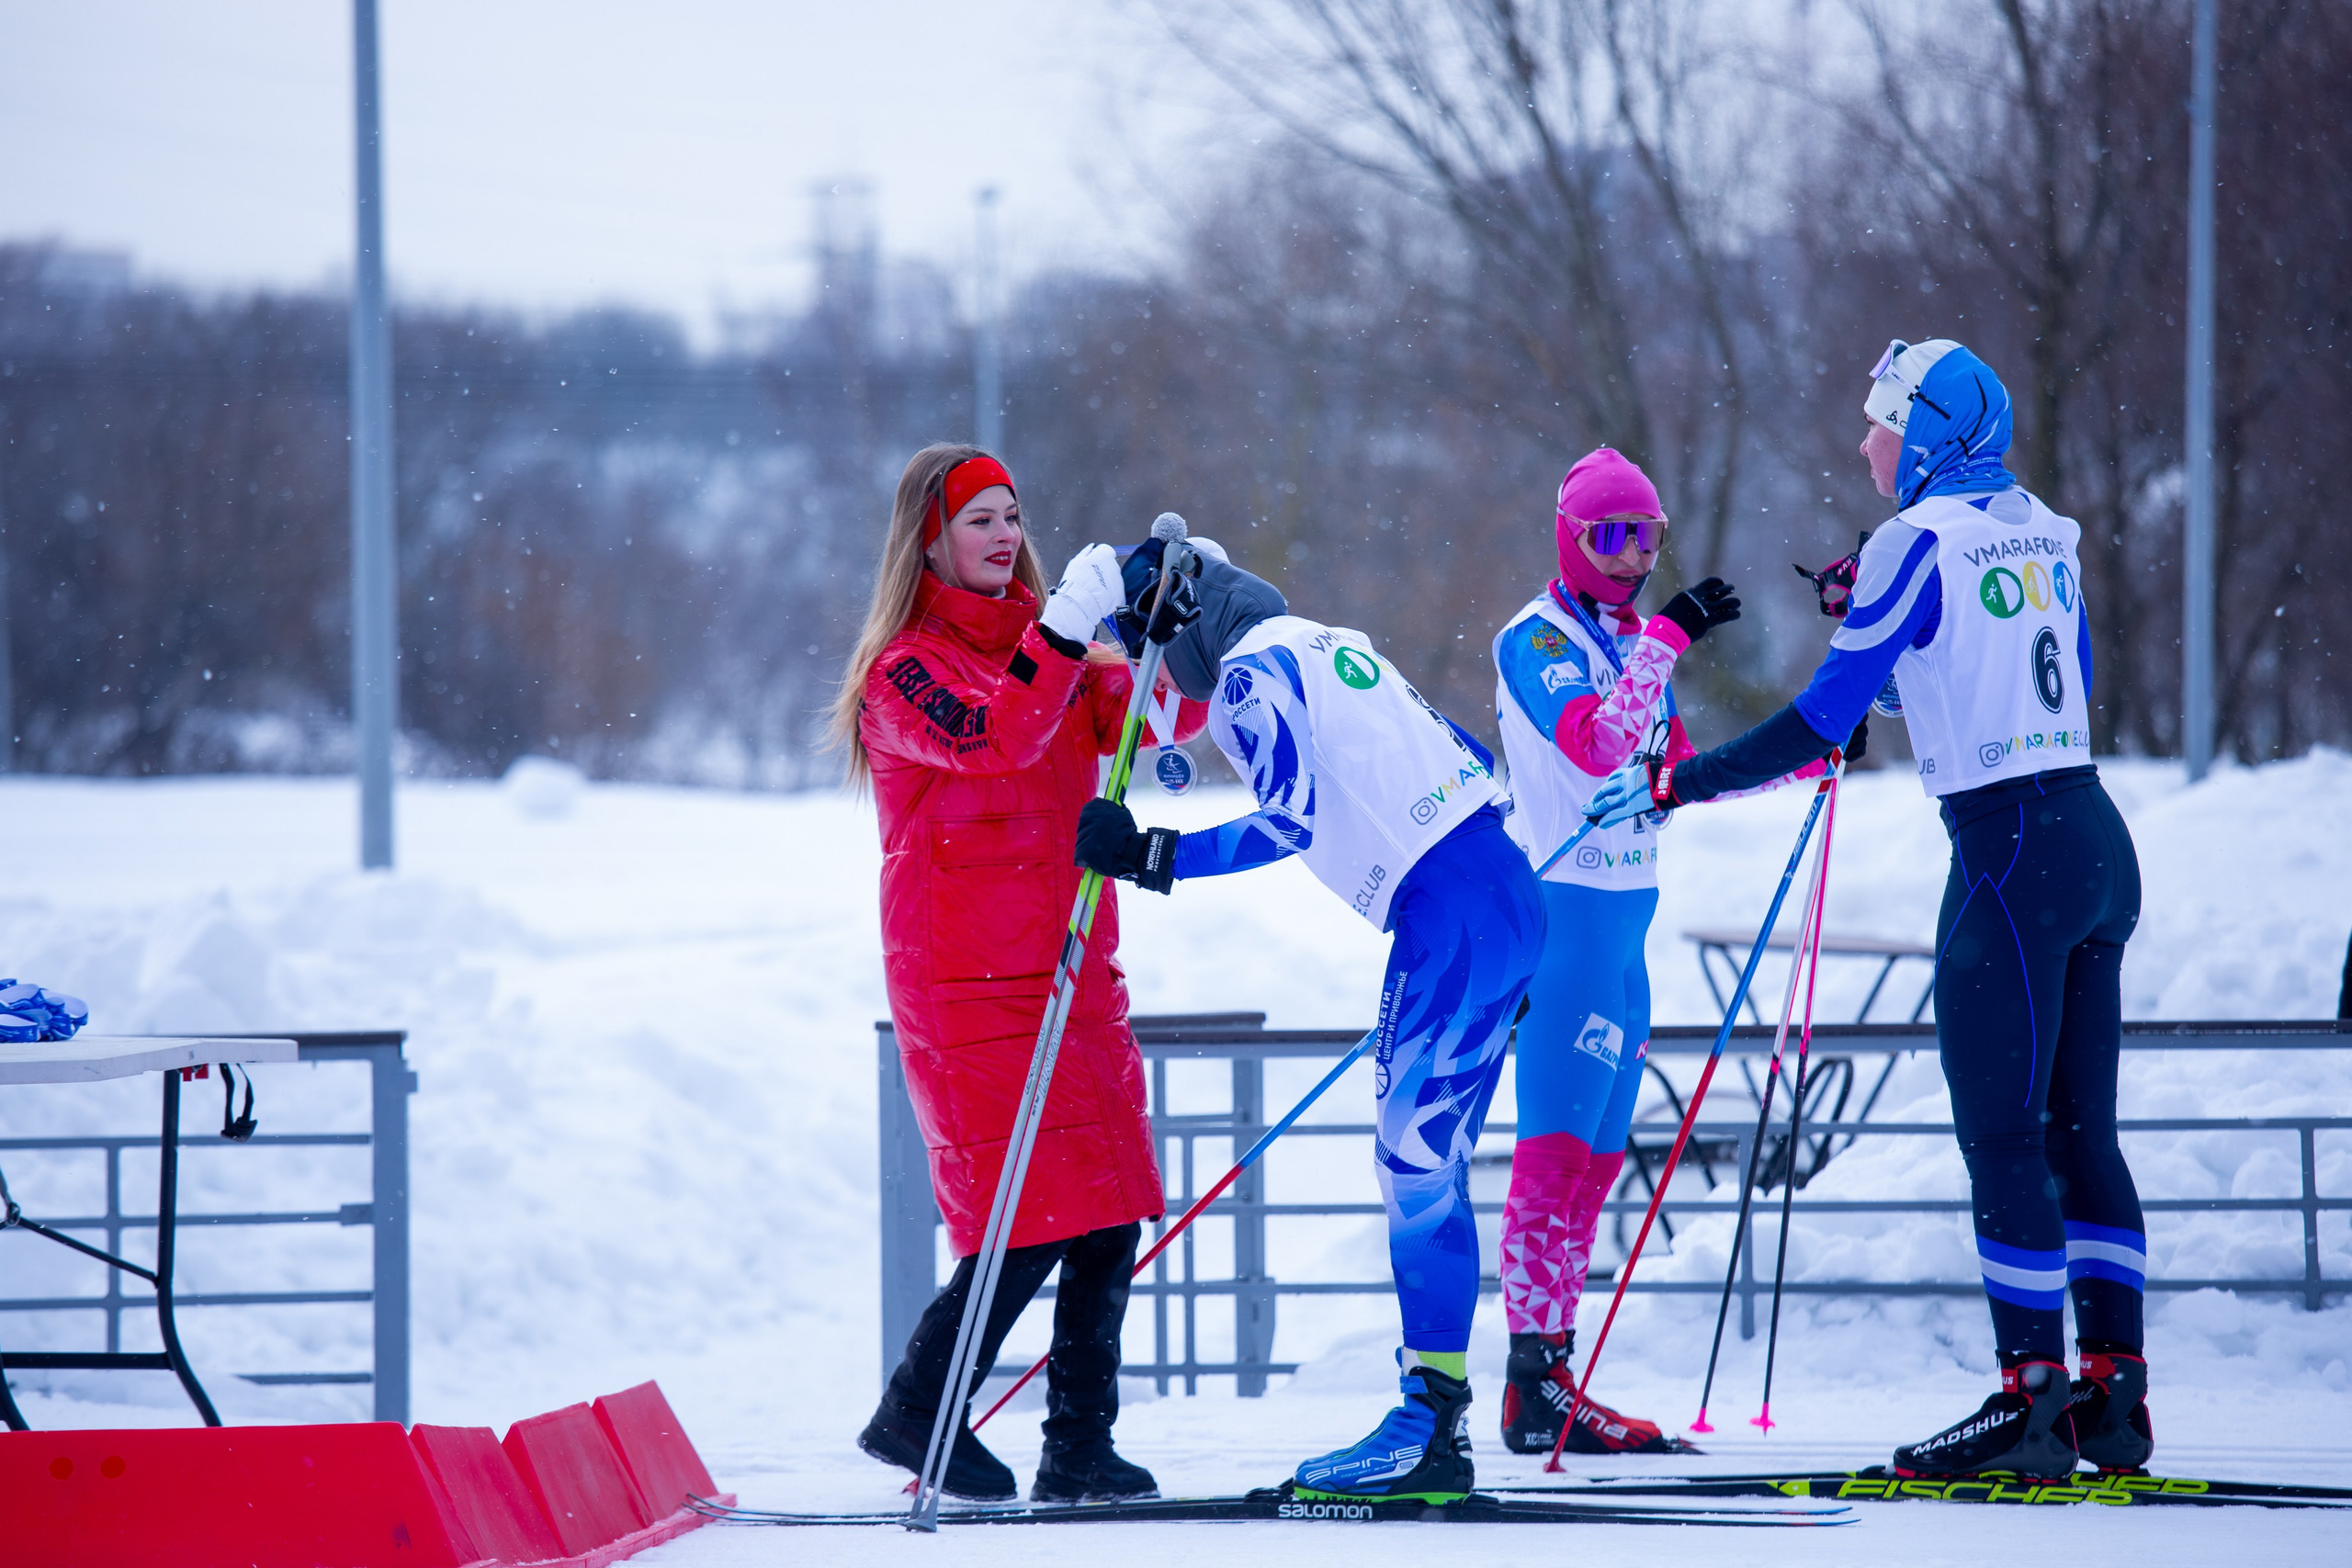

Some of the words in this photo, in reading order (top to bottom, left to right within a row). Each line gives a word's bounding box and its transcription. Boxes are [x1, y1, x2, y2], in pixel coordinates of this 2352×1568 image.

[2030, 626, 2065, 715] 6
[1540, 1380, 1629, 1441] alpina
[1305, 1444, 1424, 1485] SPINE
